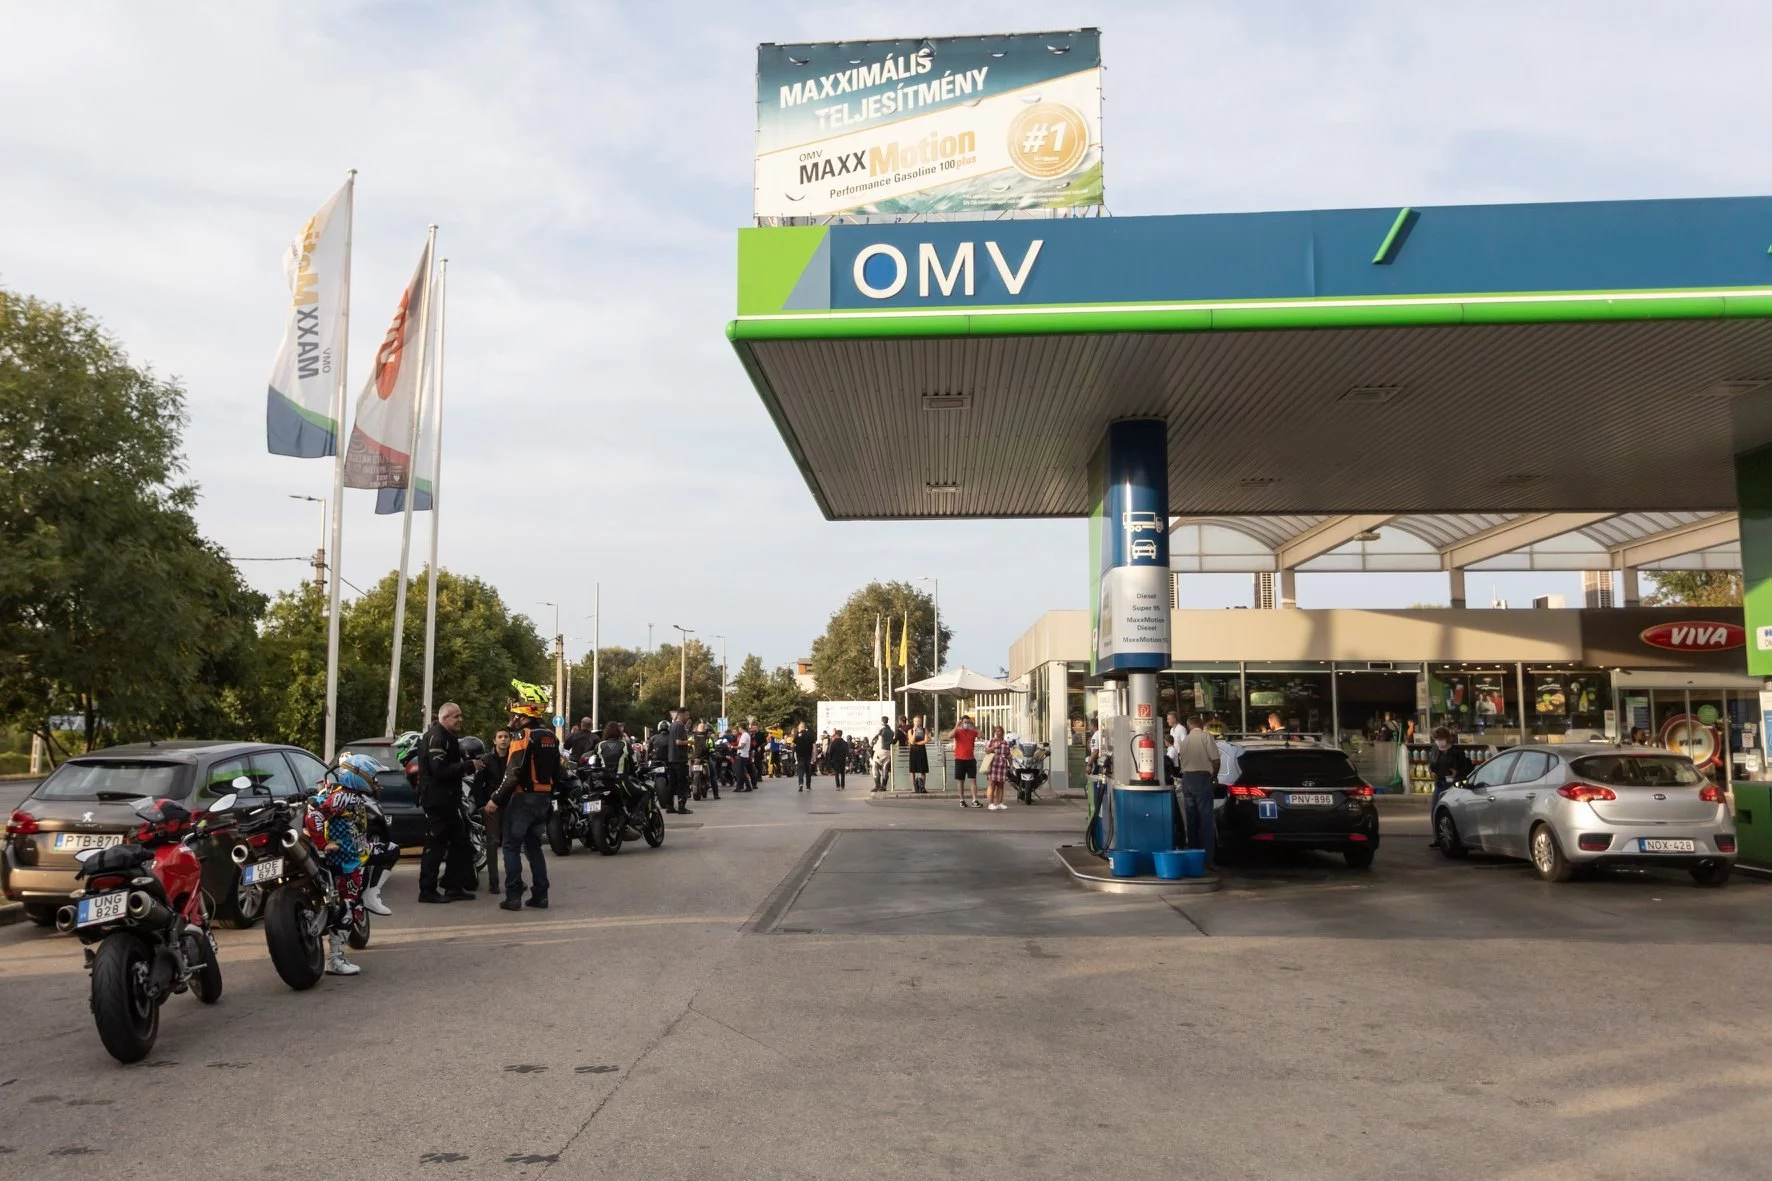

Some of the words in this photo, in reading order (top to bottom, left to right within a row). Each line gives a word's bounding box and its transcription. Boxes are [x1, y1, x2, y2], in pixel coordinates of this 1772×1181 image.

[780, 48, 932, 108] MAXXIMÁLIS
[815, 67, 988, 130] TELJESÍTMÉNY
[1023, 121, 1066, 153] #1
[799, 149, 823, 162] OMV
[830, 178, 891, 198] Performance
[894, 166, 937, 183] Gasoline
[853, 240, 1043, 299] OMV
[1671, 626, 1728, 645] VIVA
[1291, 795, 1331, 804] PNV-896
[1260, 801, 1275, 816] T
[65, 834, 120, 847] PTB-870
[1647, 841, 1692, 850] NOX-428
[257, 860, 278, 871] UOE
[258, 869, 277, 879] 673
[95, 895, 122, 908] UNG
[96, 905, 119, 918] 828
